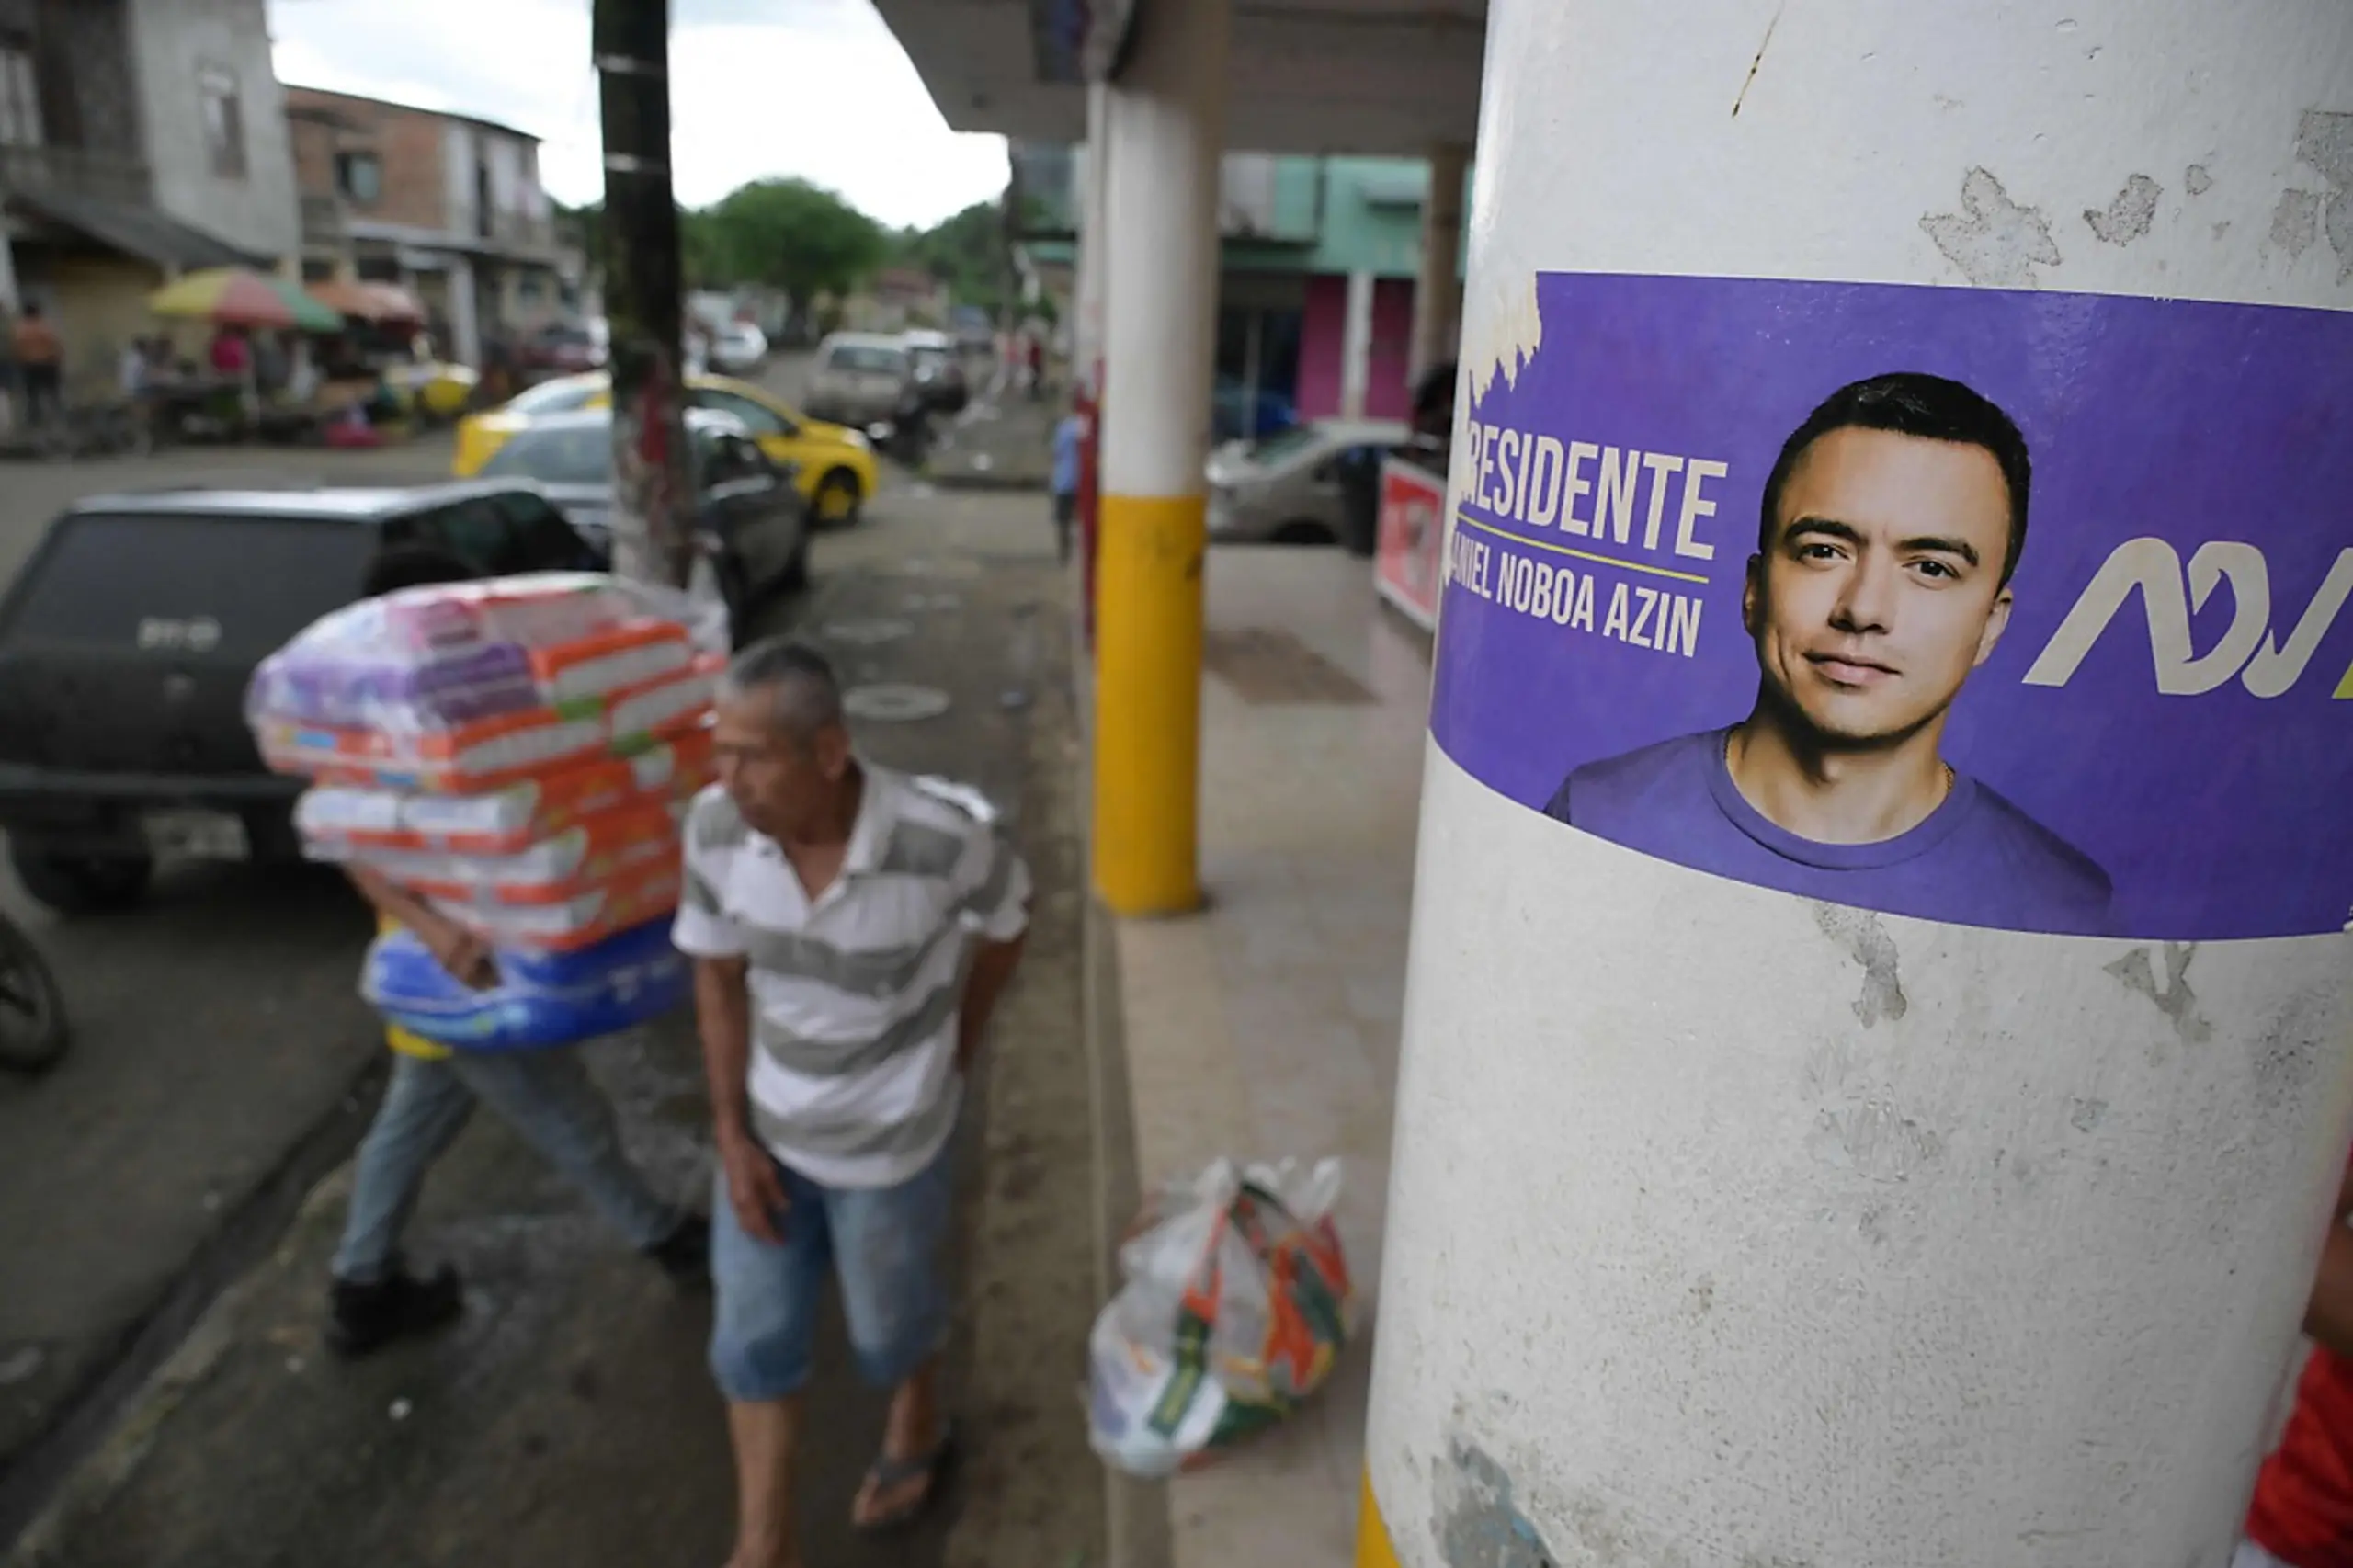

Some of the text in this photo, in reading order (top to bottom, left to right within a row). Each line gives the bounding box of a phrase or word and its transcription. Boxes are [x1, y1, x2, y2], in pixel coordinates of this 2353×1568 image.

[1461, 419, 1728, 561] RESIDENTE
[1451, 530, 1703, 658] ANIEL NOBOA AZIN
